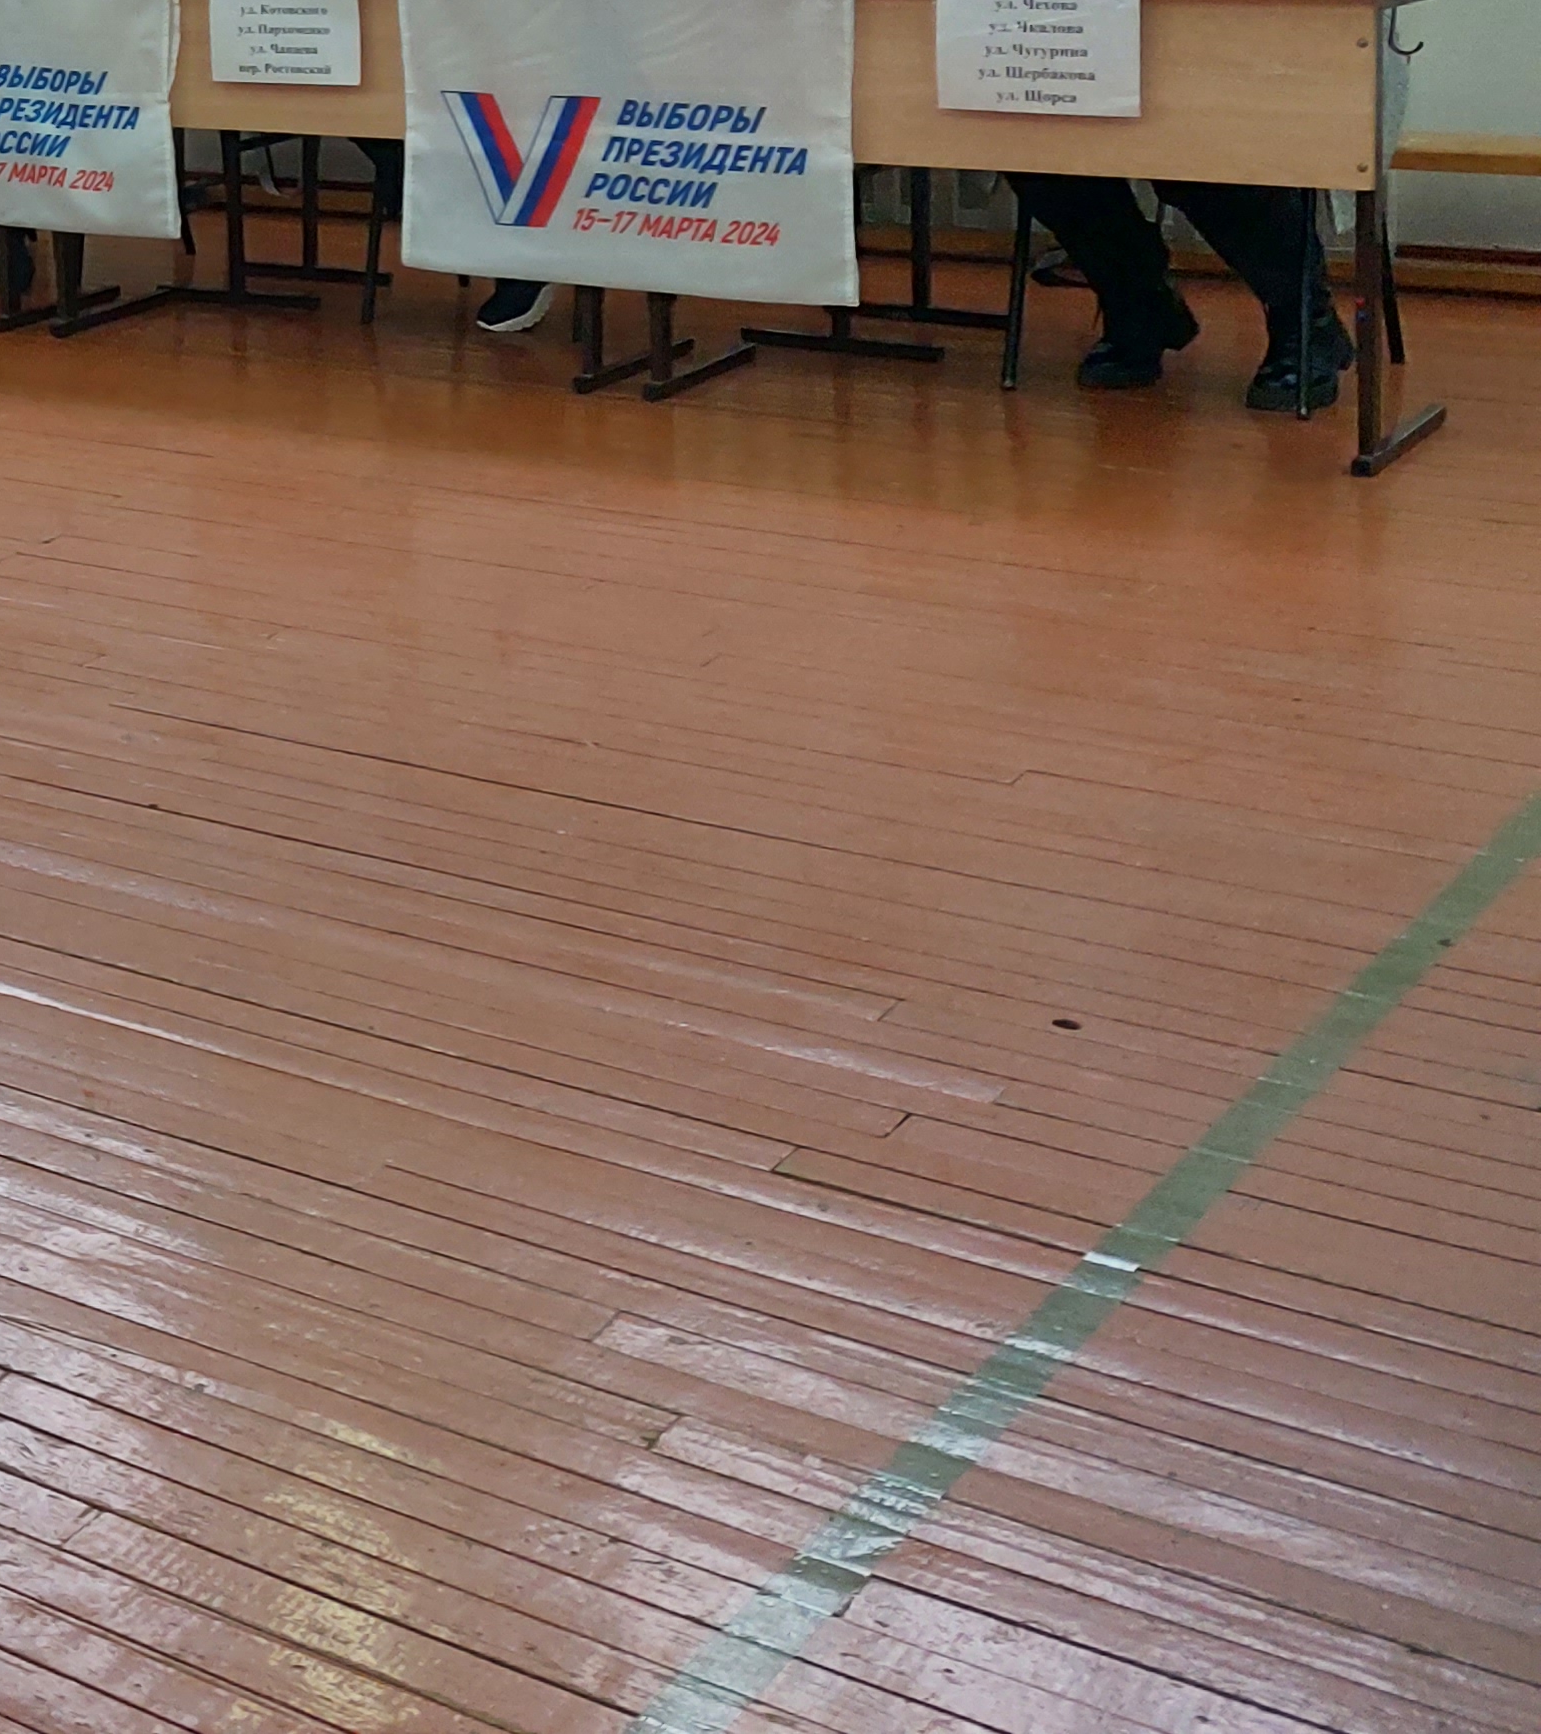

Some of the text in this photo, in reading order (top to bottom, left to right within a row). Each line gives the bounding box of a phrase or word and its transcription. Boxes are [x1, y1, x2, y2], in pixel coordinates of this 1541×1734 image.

[617, 99, 767, 134] ВЫБОРЫ
[601, 136, 808, 176] ПРЕЗИДЕНТА
[8, 162, 68, 189] МАРТА
[69, 169, 114, 193] 2024
[584, 172, 718, 209] РОССИИ
[637, 215, 718, 243] МАРТА
[720, 220, 781, 246] 2024
